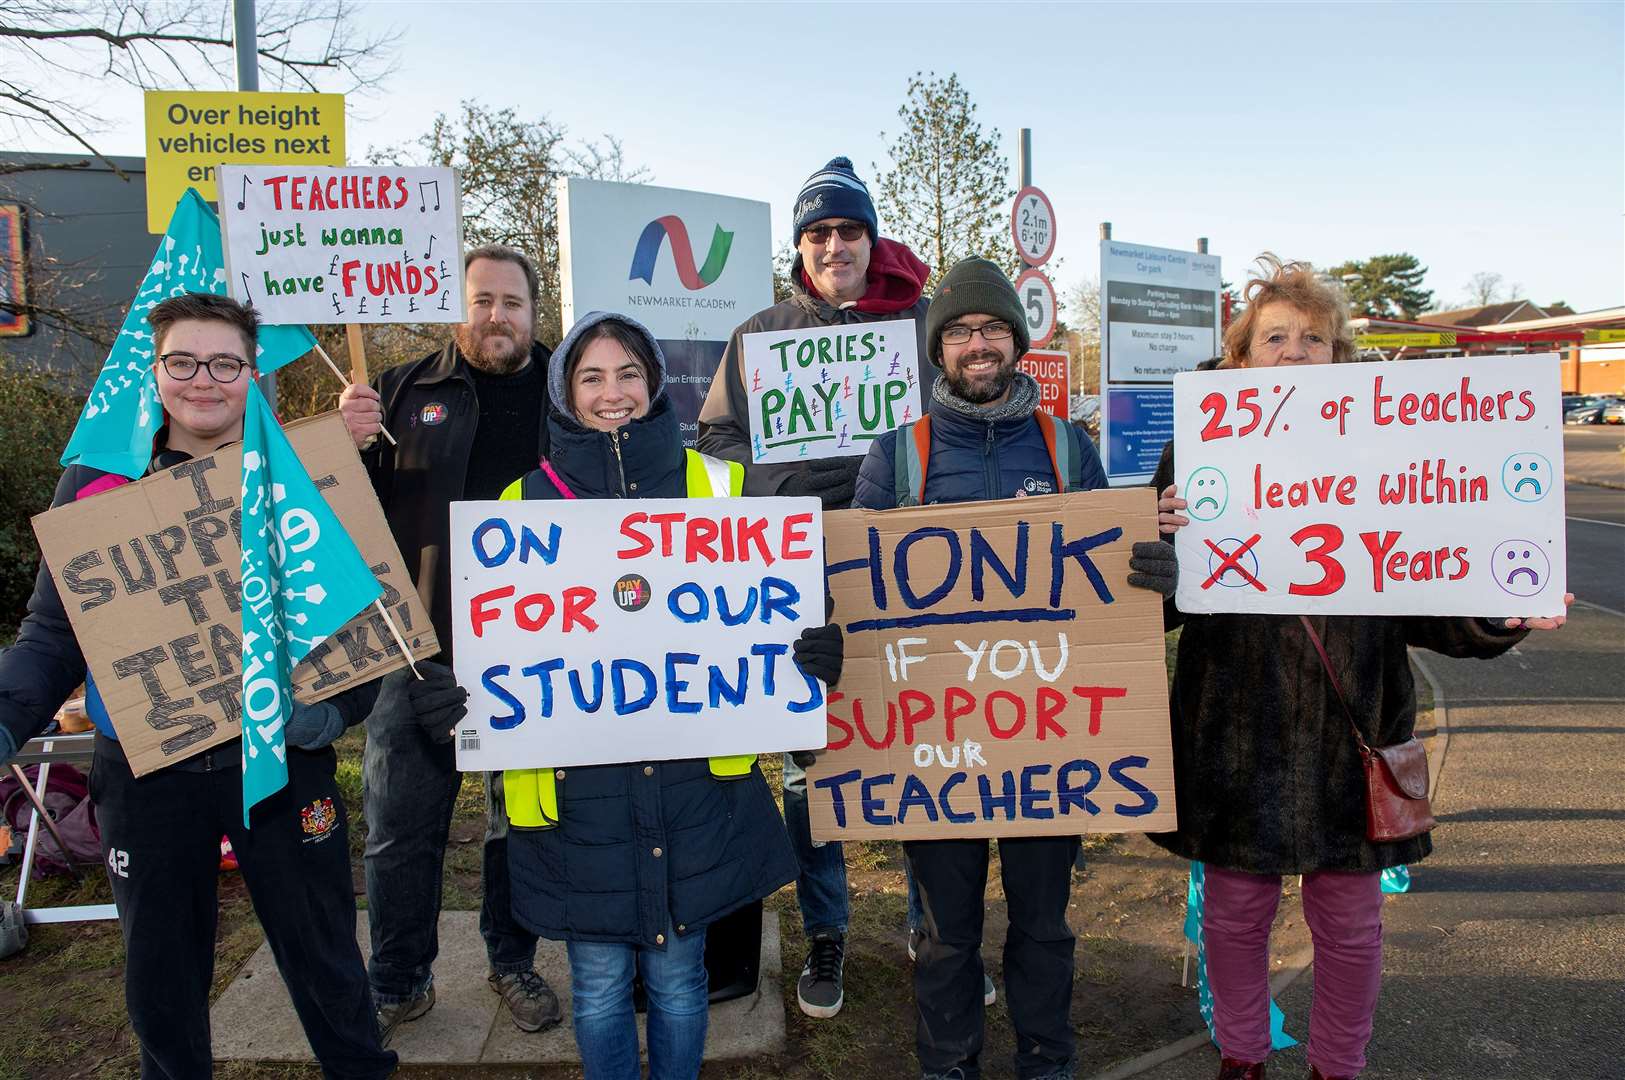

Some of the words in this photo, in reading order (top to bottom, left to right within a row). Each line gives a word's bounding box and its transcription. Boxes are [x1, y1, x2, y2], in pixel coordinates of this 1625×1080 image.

[168, 103, 230, 125] Over
[238, 105, 320, 130] height
[158, 133, 265, 153] vehicles
[274, 134, 330, 154] next
[264, 175, 409, 211] TEACHERS
[256, 222, 306, 255] just
[321, 227, 404, 246] wanna
[1022, 209, 1047, 231] 2.1m
[264, 271, 324, 295] have
[342, 259, 439, 297] FUNDS
[628, 295, 692, 308] NEWMARKET
[694, 297, 736, 309] ACADEMY
[1026, 288, 1044, 329] 5
[770, 332, 885, 372] TORIES:
[682, 374, 712, 384] Entrance
[761, 382, 840, 439] PAY
[858, 380, 907, 431] UP
[1200, 384, 1296, 442] 25%
[1321, 395, 1355, 436] of
[1374, 375, 1537, 427] teachers
[170, 456, 235, 521] I
[1254, 464, 1357, 509] leave
[1379, 459, 1488, 505] within
[472, 517, 562, 568] ON
[617, 512, 814, 567] STRIKE
[1288, 523, 1346, 597] 3
[1359, 530, 1470, 593] Years
[617, 579, 641, 592] PAY
[823, 521, 1123, 610] HONK
[470, 585, 599, 638] FOR
[667, 576, 800, 626] OUR
[885, 638, 927, 682] IF
[954, 632, 1069, 682] YOU
[481, 643, 824, 730] STUDENTS
[826, 686, 1127, 751] SUPPORT
[914, 738, 987, 768] OUR
[814, 755, 1158, 828] TEACHERS
[108, 847, 129, 878] 42
